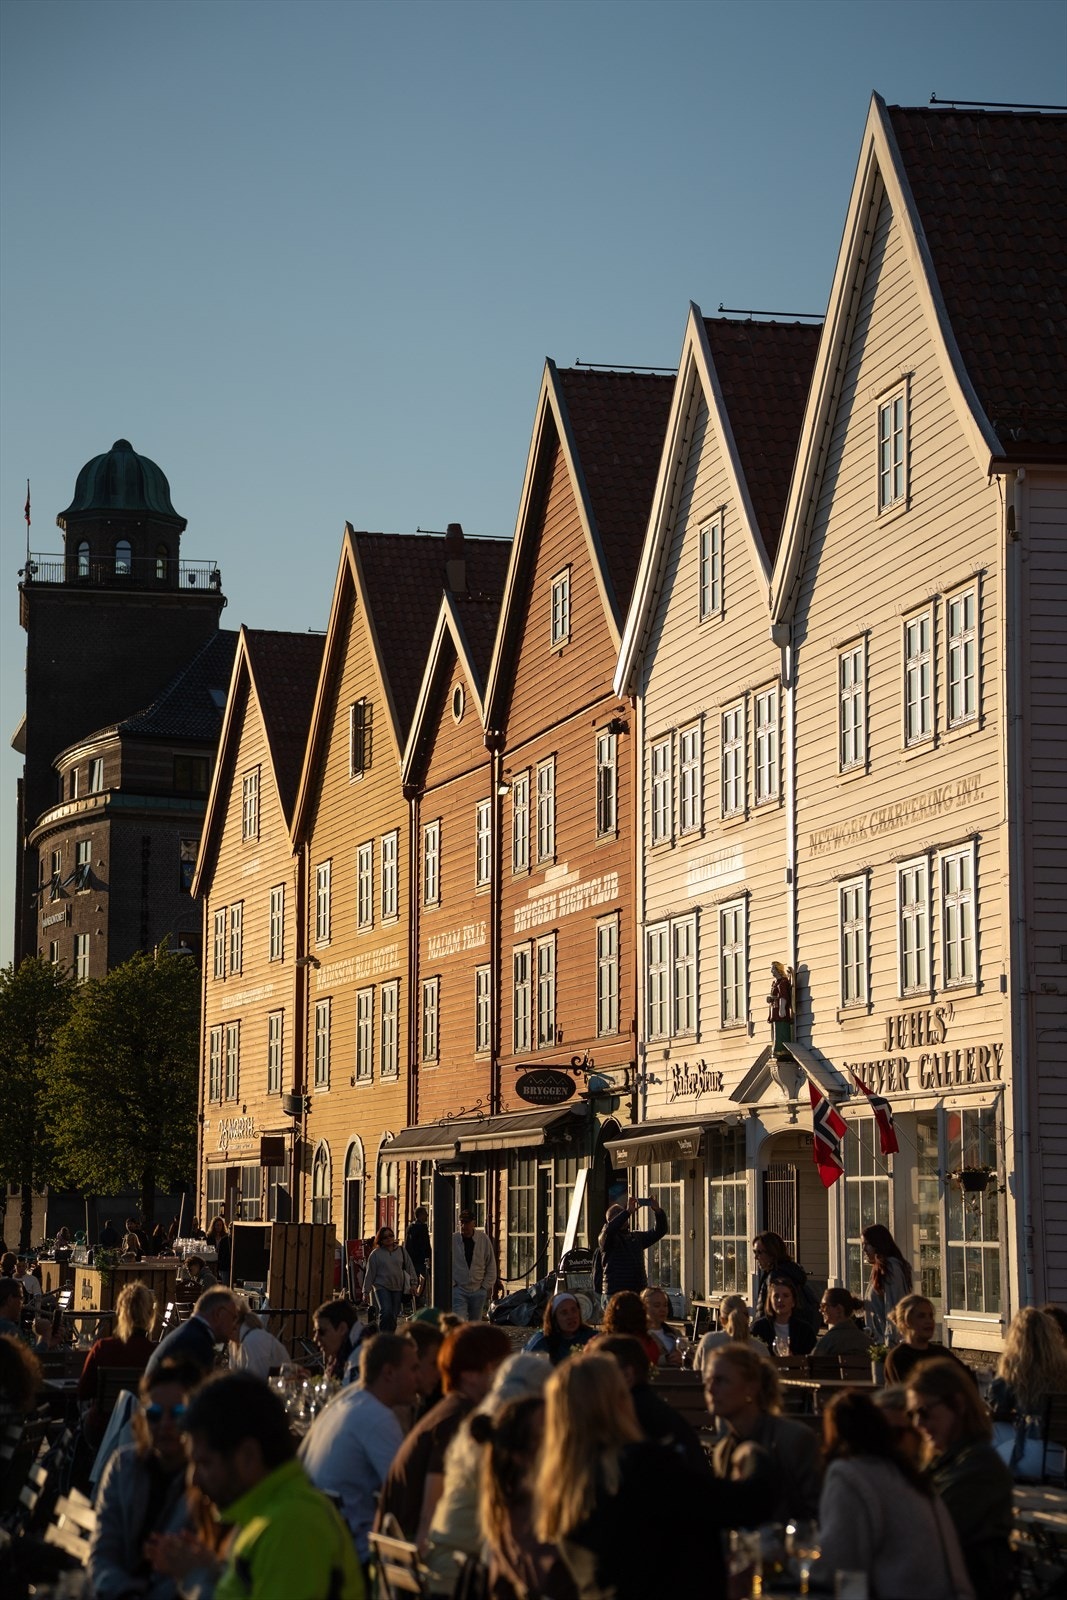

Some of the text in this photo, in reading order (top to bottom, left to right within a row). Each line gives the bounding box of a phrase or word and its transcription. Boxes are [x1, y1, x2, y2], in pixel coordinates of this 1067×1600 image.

[809, 814, 868, 856] NETWORK
[869, 784, 953, 836] CHARTERING
[513, 871, 619, 934] BRYGGEN NIGHTCLUB
[316, 943, 400, 991] RADISSON BLU HOTEL
[427, 928, 461, 960] MADAM
[918, 1043, 1003, 1090] GALLERY
[523, 1086, 569, 1096] BRYGGEN
[229, 1116, 255, 1140] NORTH
